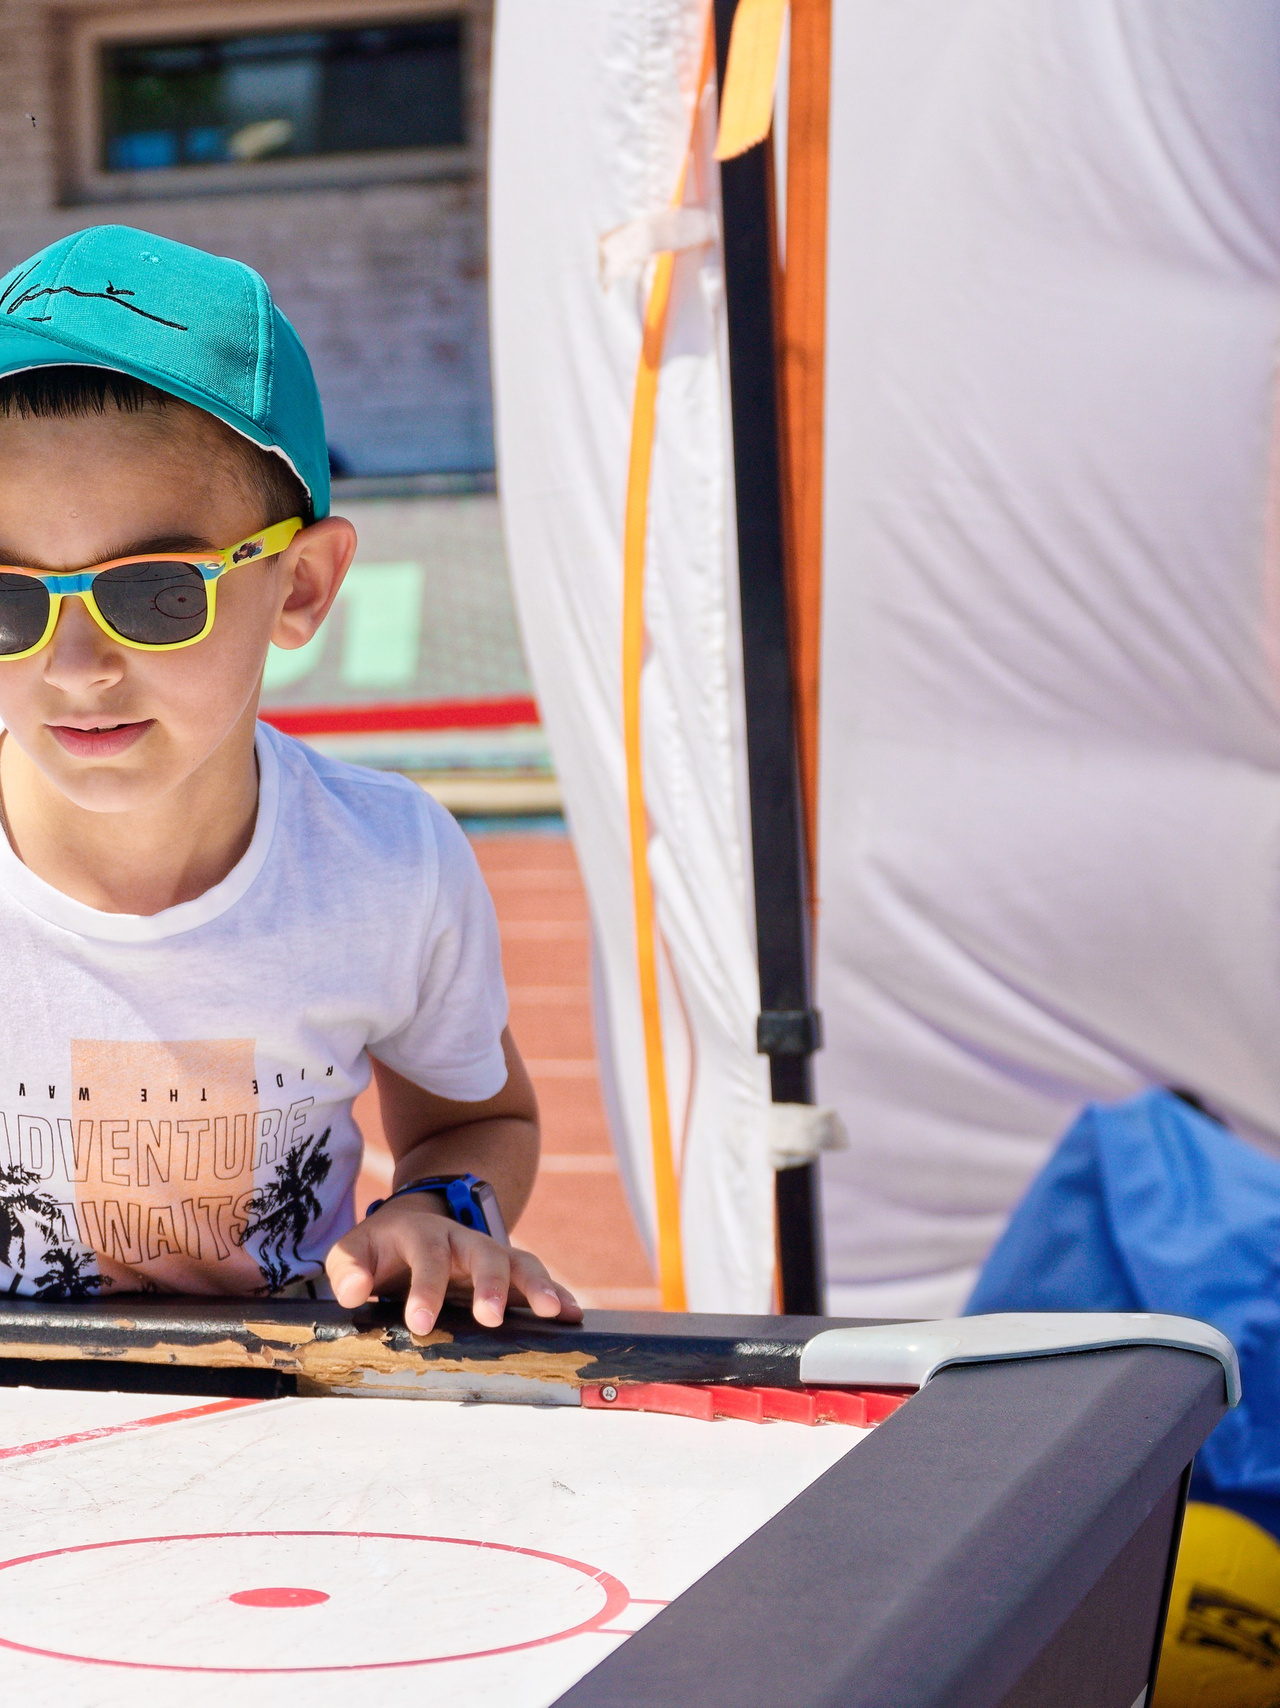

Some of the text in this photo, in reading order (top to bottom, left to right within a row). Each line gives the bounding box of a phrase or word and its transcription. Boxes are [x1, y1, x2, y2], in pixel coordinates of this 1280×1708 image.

[251, 1066, 334, 1095] RIDE
[140, 1088, 208, 1103] THE
[52, 1187, 266, 1265] AWAITS
